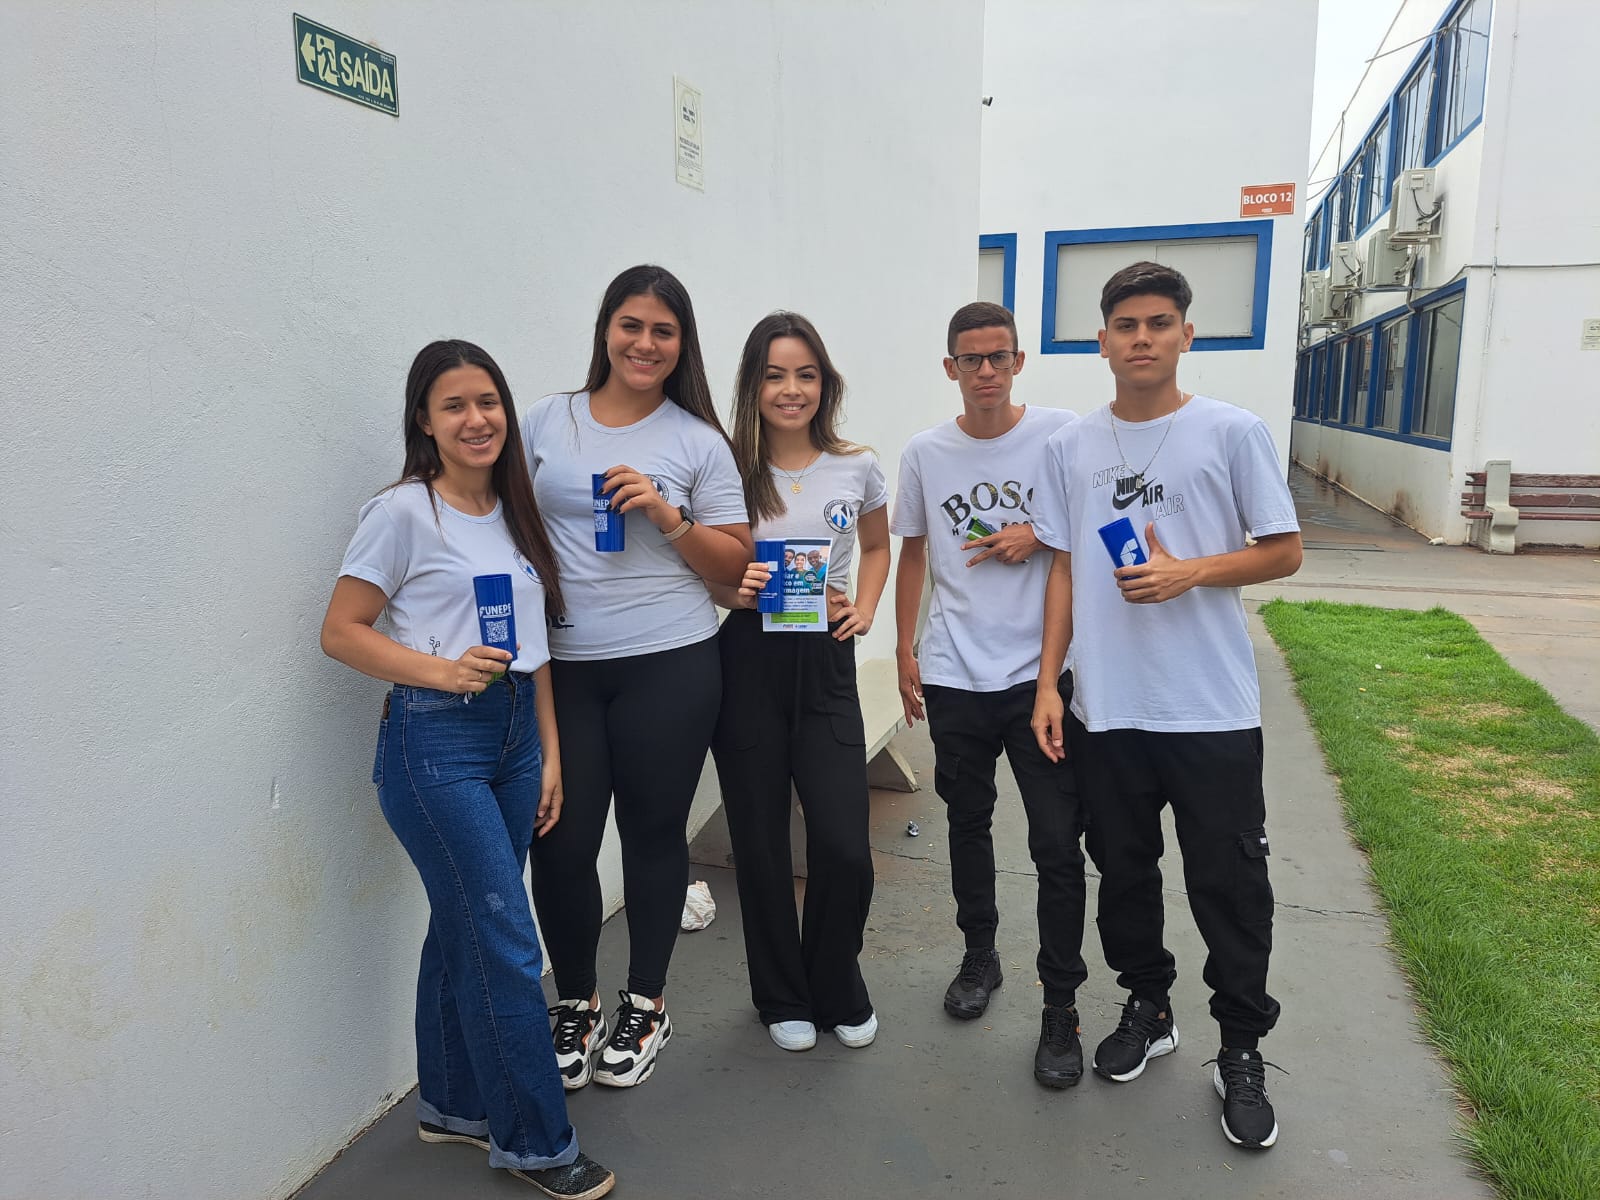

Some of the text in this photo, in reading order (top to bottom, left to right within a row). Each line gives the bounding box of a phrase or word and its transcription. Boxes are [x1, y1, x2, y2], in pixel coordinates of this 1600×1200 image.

[340, 51, 394, 103] SAÍDA
[1243, 192, 1292, 205] BLOCO 12
[1092, 464, 1126, 488] NIKE
[1142, 484, 1164, 508] AIR
[1155, 494, 1185, 520] AIR
